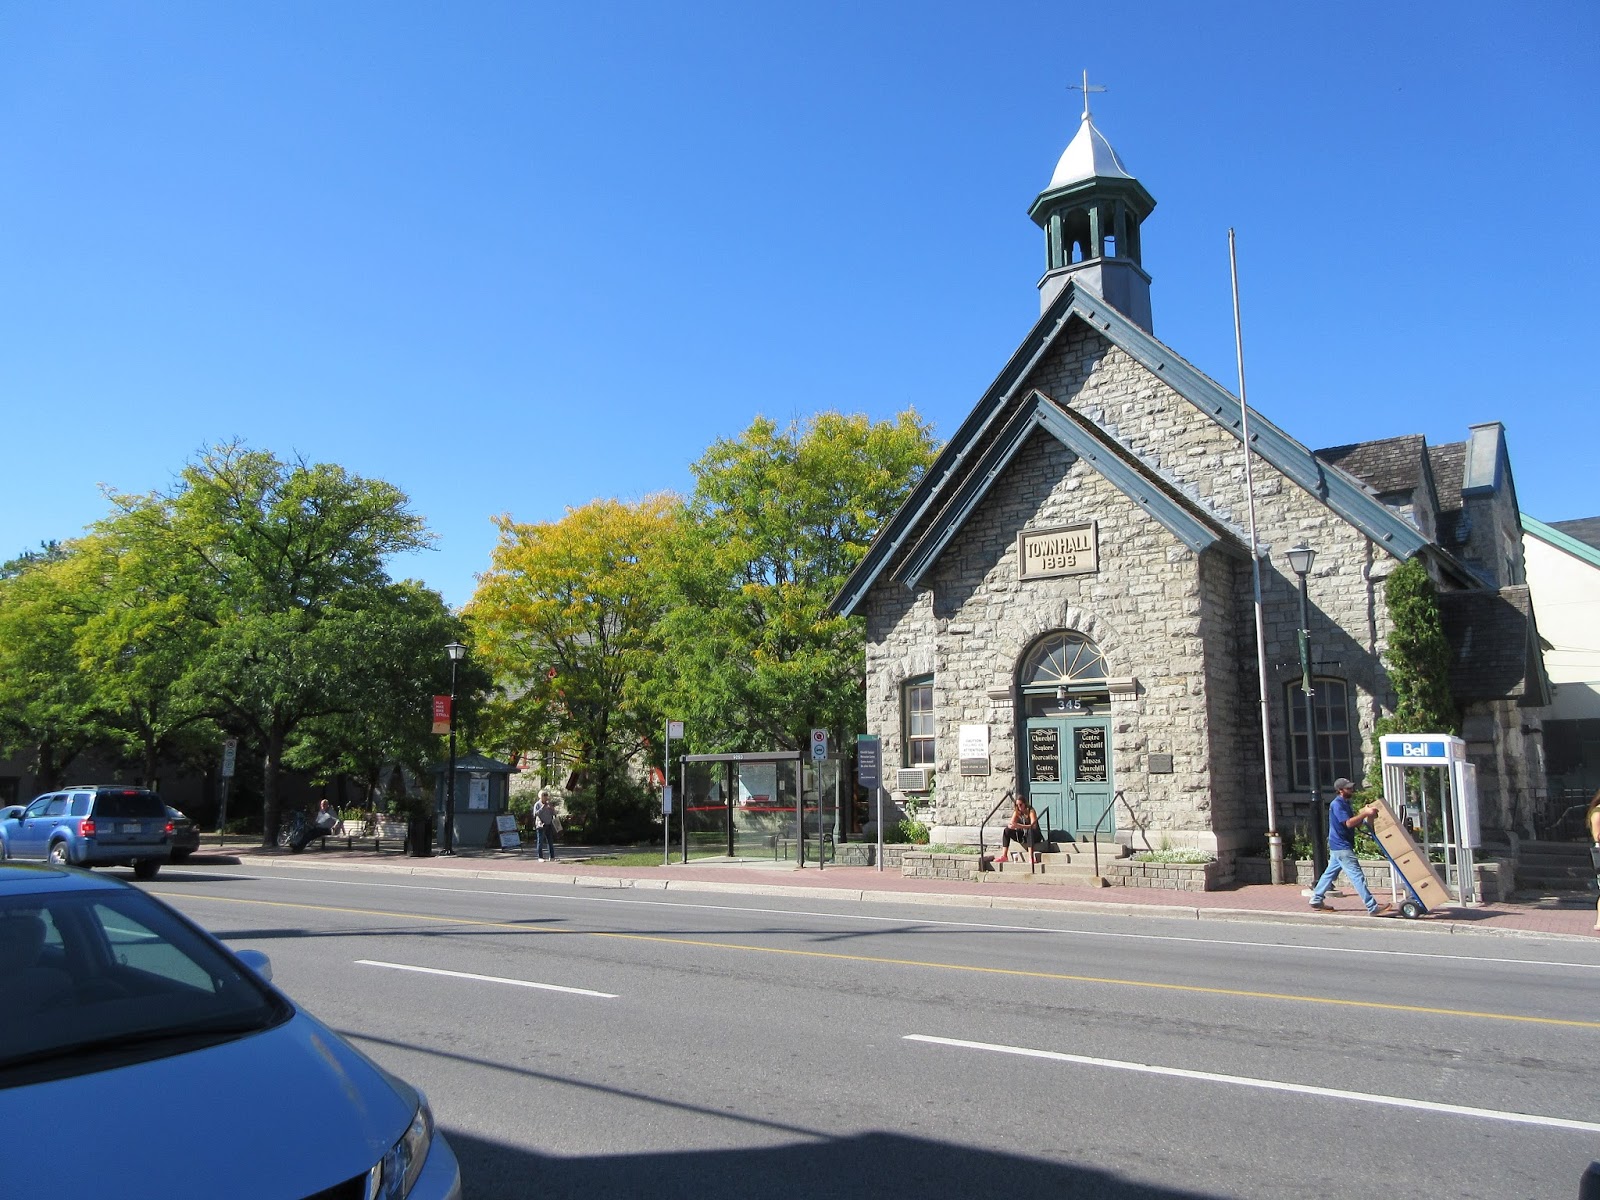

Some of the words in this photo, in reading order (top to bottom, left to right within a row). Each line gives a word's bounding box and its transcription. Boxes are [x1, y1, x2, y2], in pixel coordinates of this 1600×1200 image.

[1026, 539, 1059, 558] TOWN
[1060, 535, 1091, 555] HALL
[1058, 699, 1081, 710] 345
[1403, 743, 1428, 756] Bell
